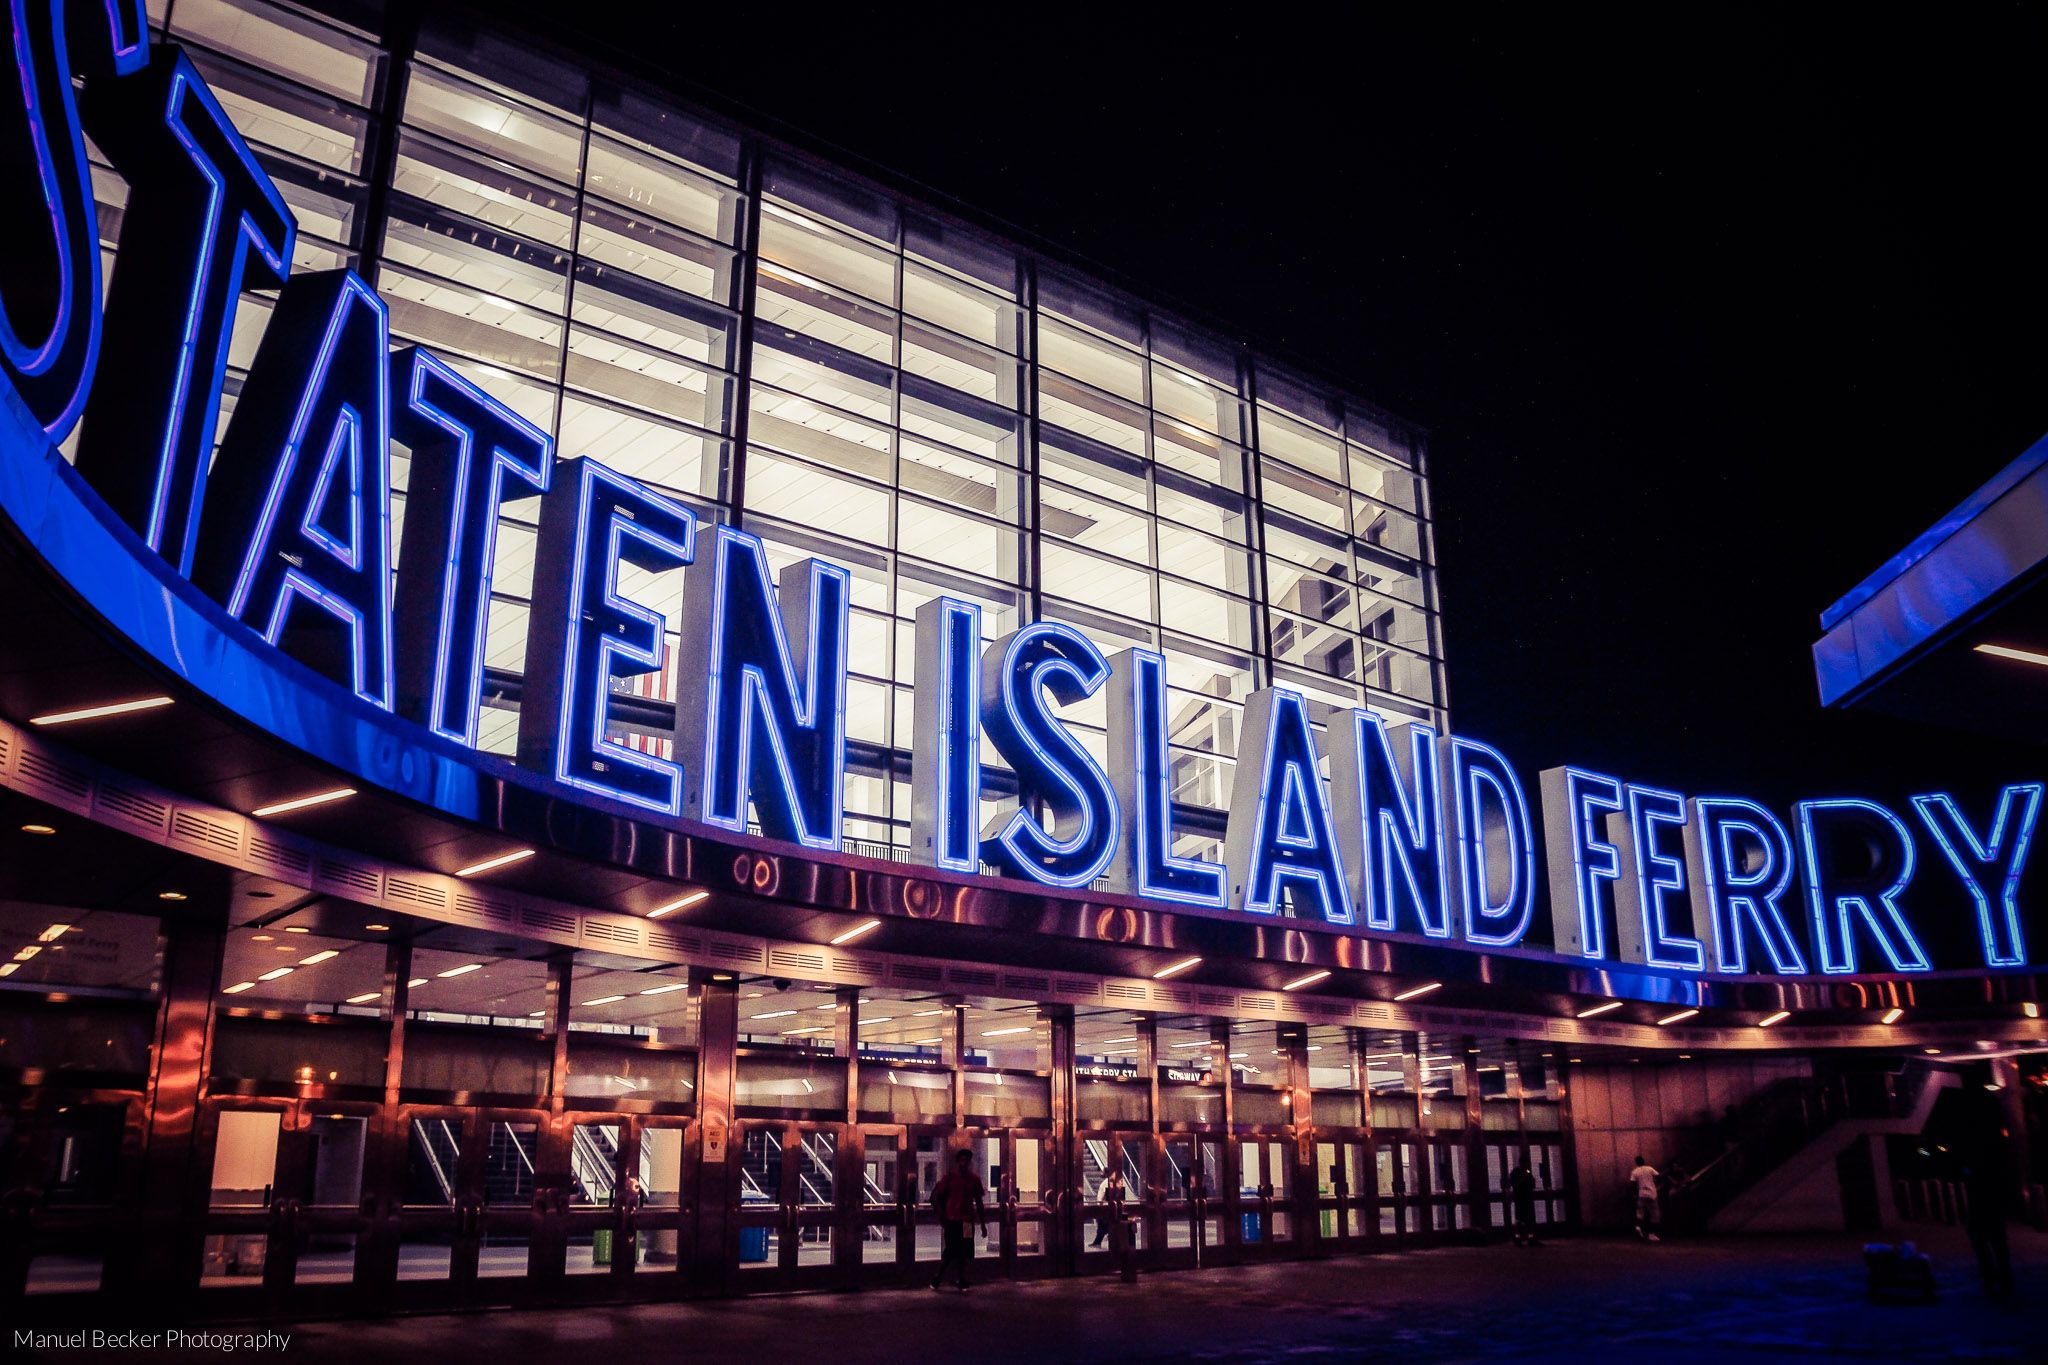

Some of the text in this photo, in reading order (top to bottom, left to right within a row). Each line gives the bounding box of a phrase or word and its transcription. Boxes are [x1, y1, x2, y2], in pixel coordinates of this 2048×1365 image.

[0, 0, 2045, 975] STATEN ISLAND FERRY
